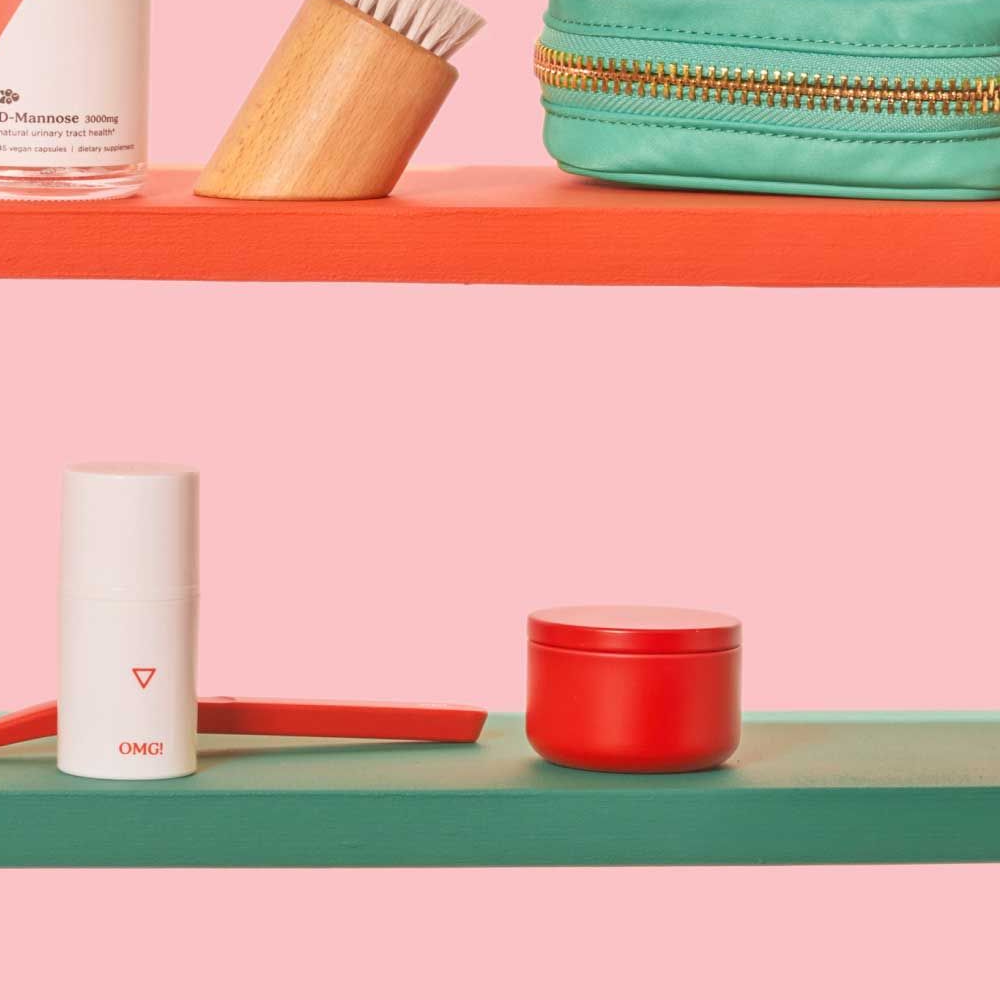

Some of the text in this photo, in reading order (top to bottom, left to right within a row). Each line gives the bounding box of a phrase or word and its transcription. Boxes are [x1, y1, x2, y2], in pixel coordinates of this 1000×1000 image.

[84, 114, 119, 124] 3000mg
[31, 129, 63, 138] urinary
[65, 129, 86, 137] tract
[34, 145, 67, 153] capsules
[77, 145, 102, 153] dietary
[118, 741, 164, 756] OMG!
